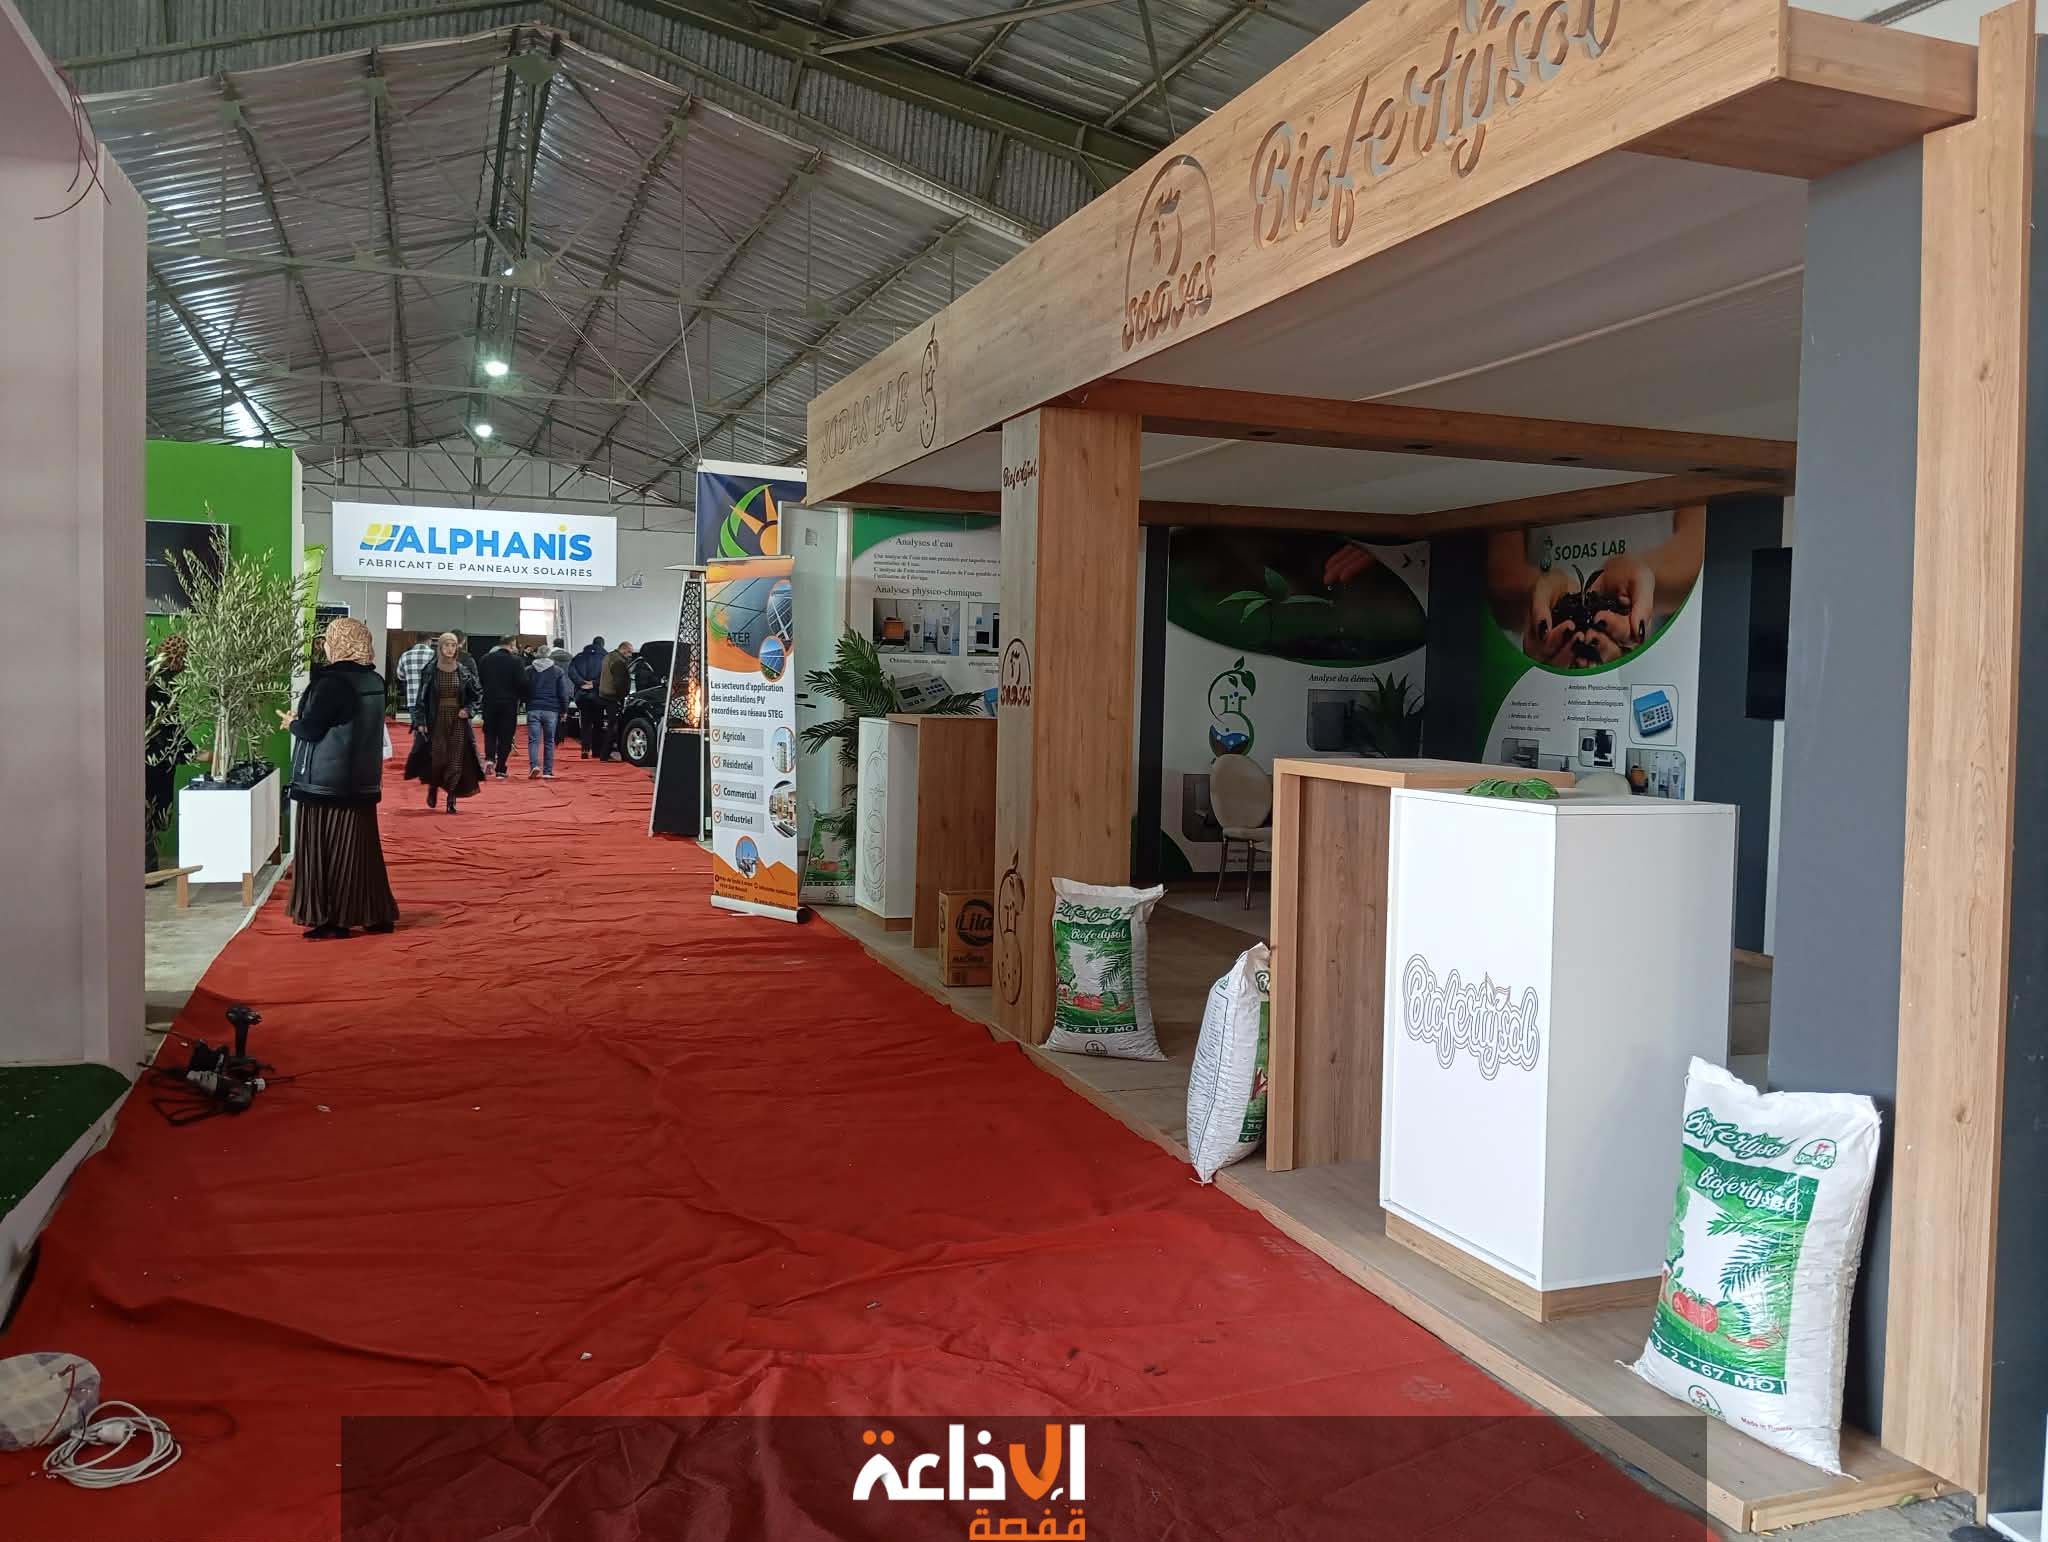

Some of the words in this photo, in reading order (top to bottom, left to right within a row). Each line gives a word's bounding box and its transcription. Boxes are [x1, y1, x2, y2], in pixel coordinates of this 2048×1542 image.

[896, 537, 931, 548] Analyses
[932, 539, 953, 548] d'eau
[1554, 542, 1598, 561] SODAS
[1601, 540, 1626, 557] LAB
[359, 558, 432, 570] FABRICANT
[437, 562, 454, 571] DE
[459, 563, 529, 574] PANNEAUX
[533, 566, 593, 577] SOLAIRES
[874, 585, 910, 596] Analyses
[727, 632, 750, 643] ATER
[710, 681, 721, 690] Les
[721, 682, 745, 690] secteurs
[745, 682, 784, 693] d'application
[710, 693, 722, 702] des
[723, 694, 756, 704] installations
[756, 696, 766, 705] PV
[767, 709, 784, 719] STEG
[722, 731, 746, 742] Agricole
[722, 759, 753, 771] Résidentiel
[723, 787, 757, 800] Commercial
[723, 813, 753, 824] Industriel
[1701, 1364, 1725, 1379] 67
[1734, 1374, 1776, 1391] MO
